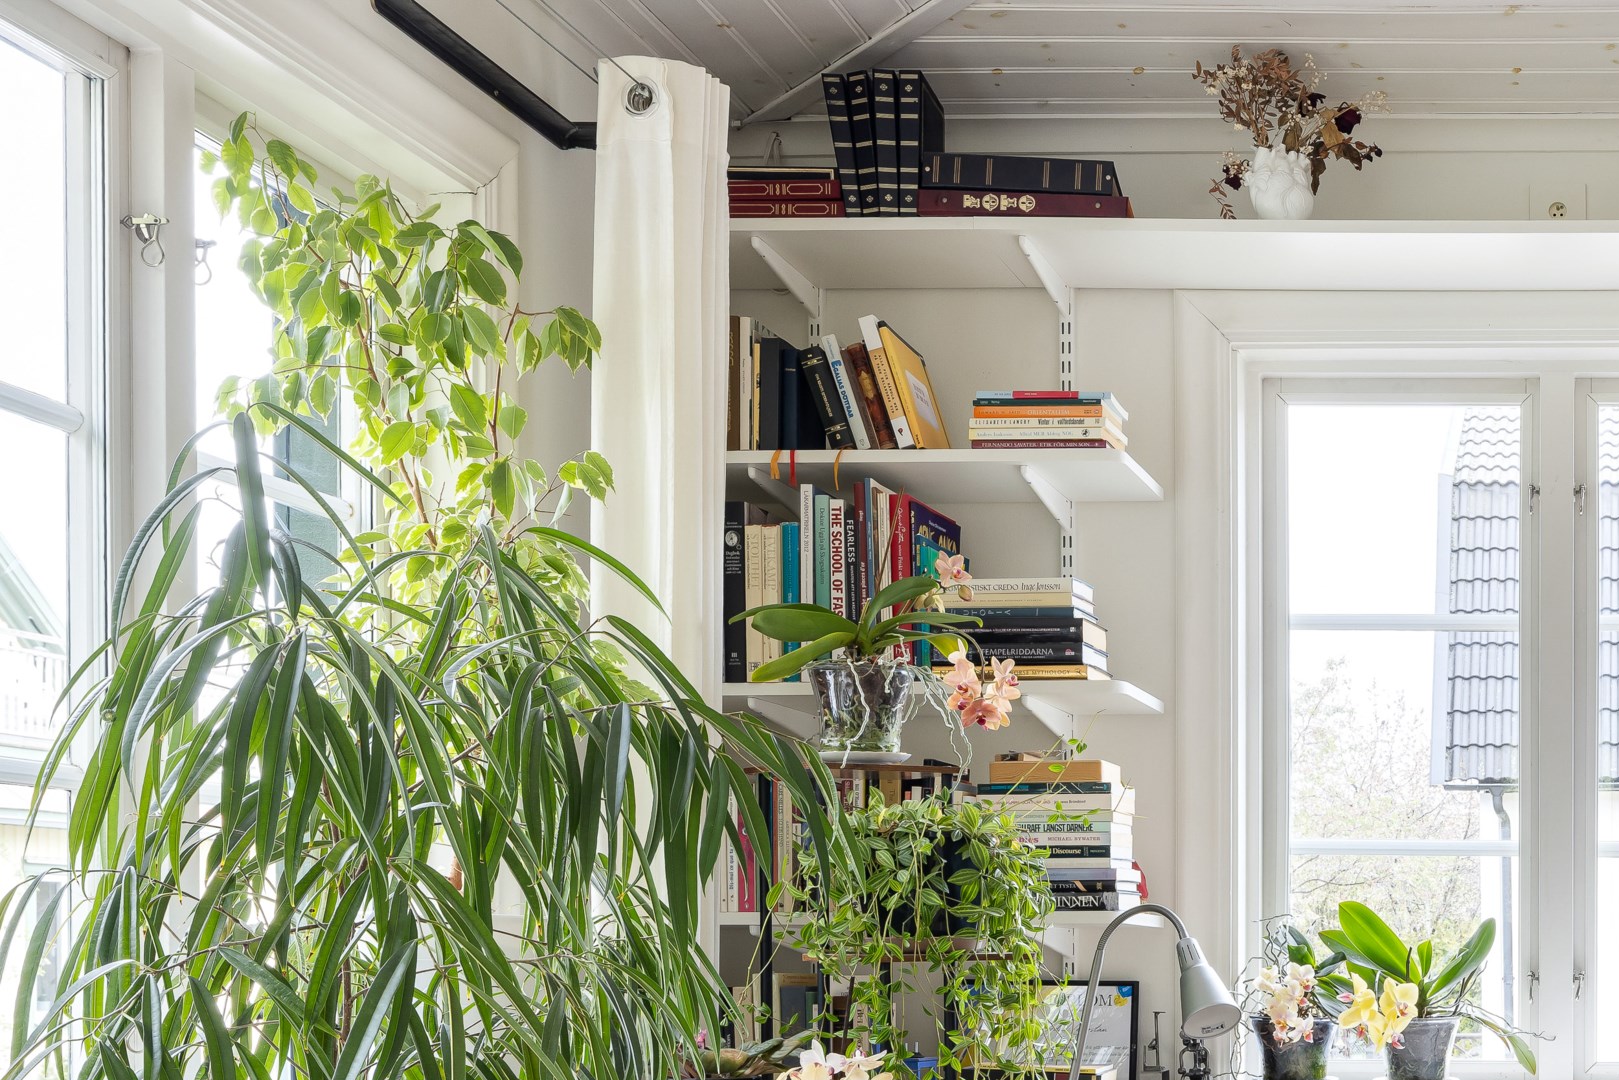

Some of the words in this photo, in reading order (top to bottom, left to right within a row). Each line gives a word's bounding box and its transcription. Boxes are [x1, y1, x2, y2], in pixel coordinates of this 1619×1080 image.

[831, 506, 842, 528] THE
[846, 520, 855, 563] FEARLESS
[767, 535, 777, 591] TVEKAMP
[831, 530, 842, 577] SCHOOL
[831, 580, 842, 594] OF
[1021, 582, 1035, 592] Inge
[1036, 582, 1061, 591] Jonsson
[1052, 847, 1082, 855] Discourse
